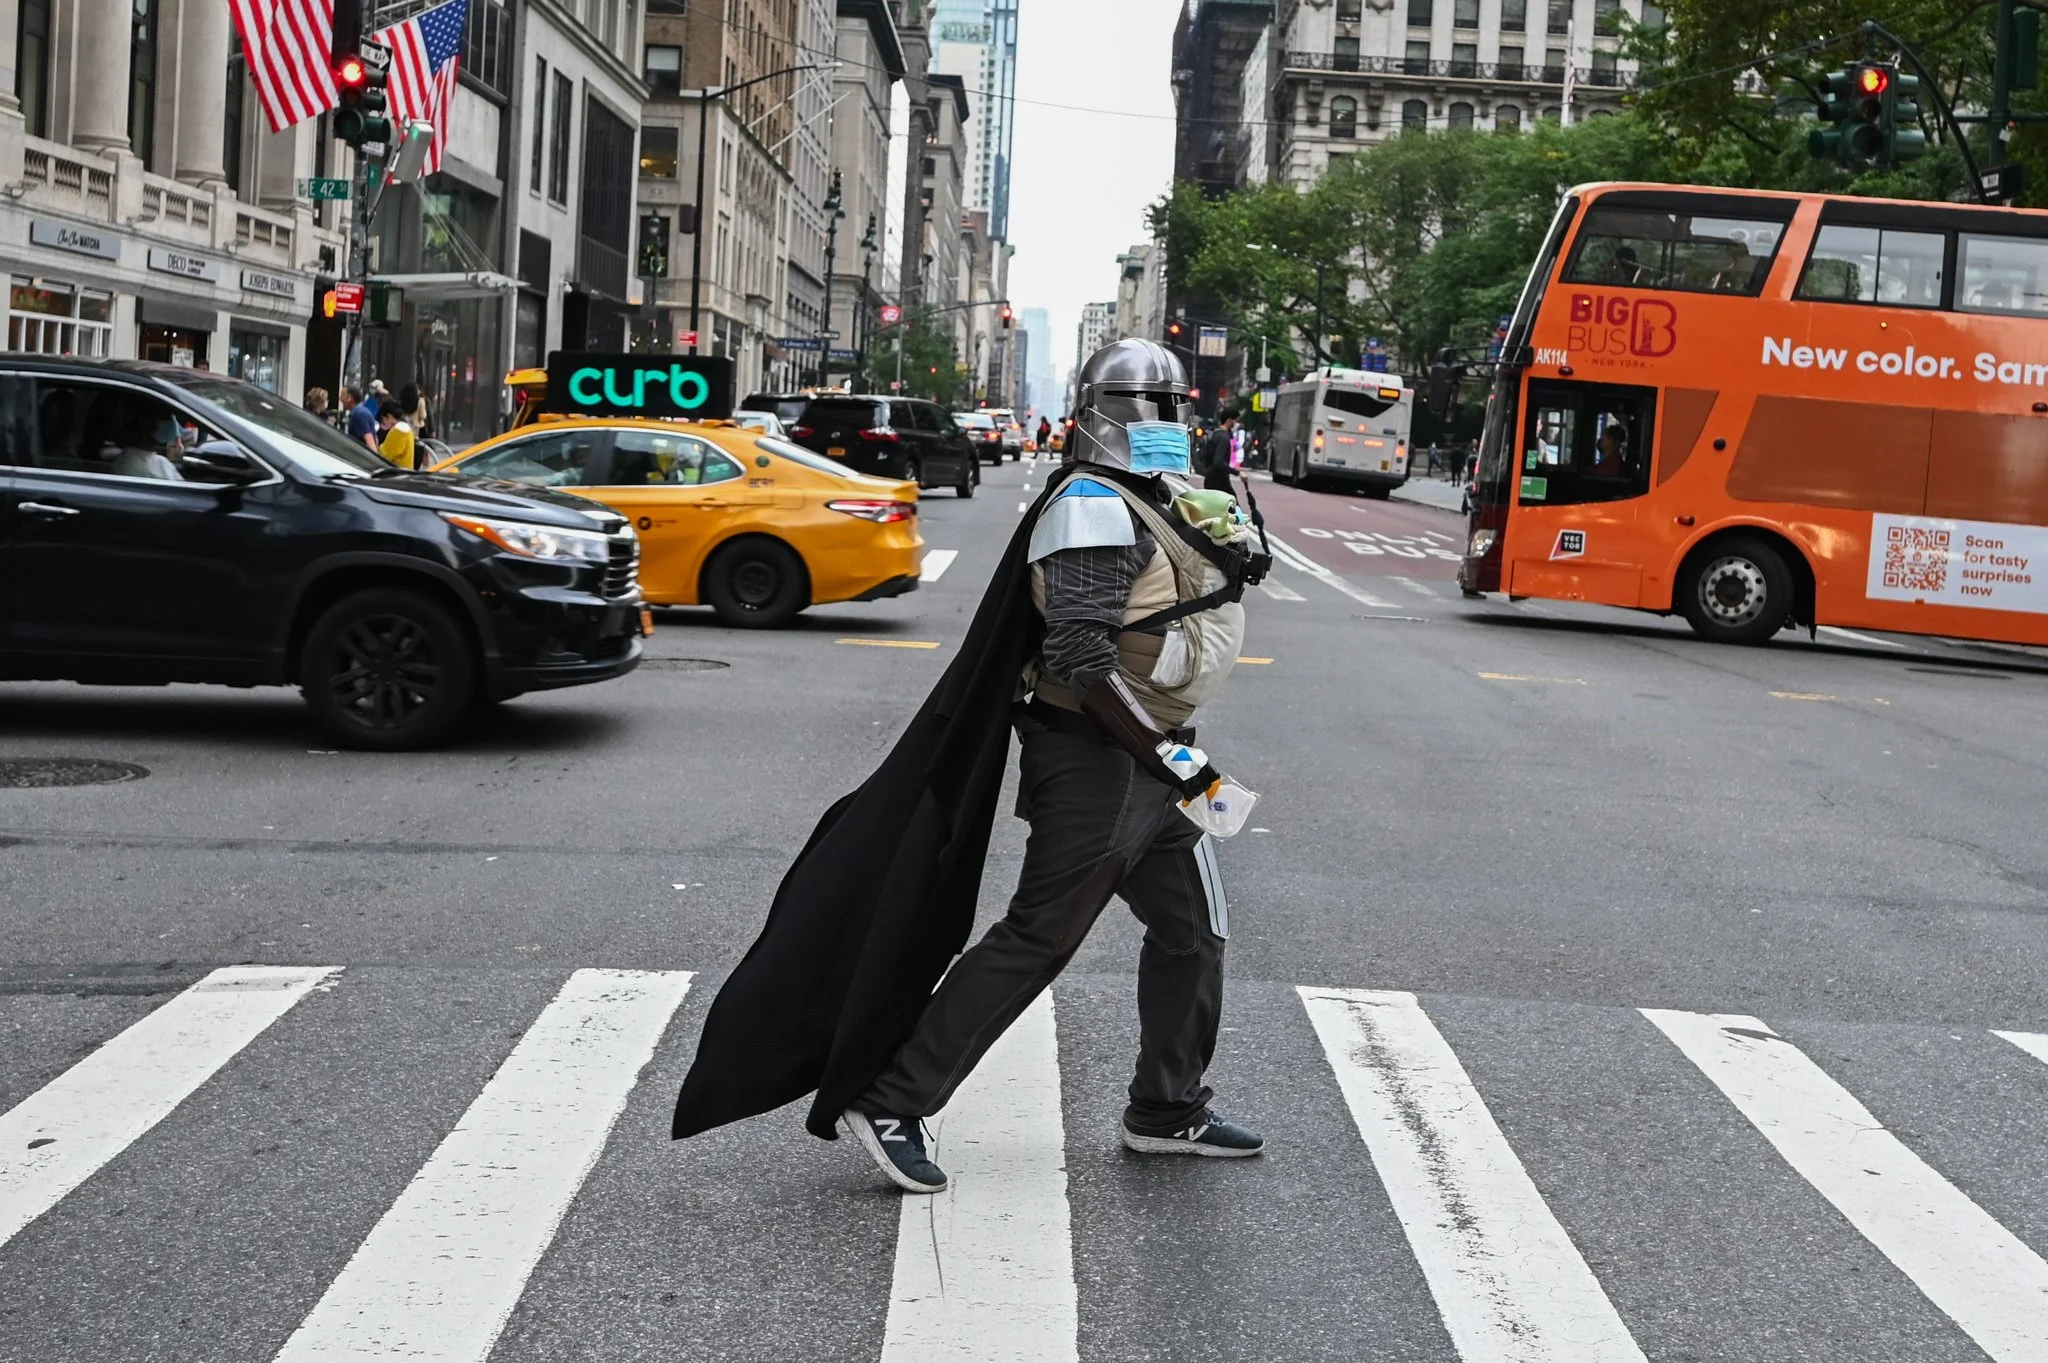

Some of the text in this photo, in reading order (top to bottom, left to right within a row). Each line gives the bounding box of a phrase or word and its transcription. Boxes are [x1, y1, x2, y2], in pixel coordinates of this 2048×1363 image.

[309, 181, 316, 197] E
[320, 181, 335, 198] 42
[168, 253, 187, 271] DECO
[249, 273, 295, 295] JOSEPH EDWARDS
[1570, 293, 1630, 326] BIG
[1567, 325, 1627, 356] BUS
[1535, 347, 1568, 367] AK114
[1591, 358, 1647, 369] NEW YORK
[1761, 336, 1848, 370] New
[1856, 345, 1962, 380] color.
[568, 363, 709, 409] curb
[1563, 535, 1581, 543] VEC
[1563, 542, 1581, 550] TOR
[1965, 534, 2004, 550] Scan
[1343, 541, 1464, 562] BUS
[1963, 550, 2029, 571] for tasty
[1962, 569, 2032, 584] surprises
[1960, 584, 1993, 598] now
